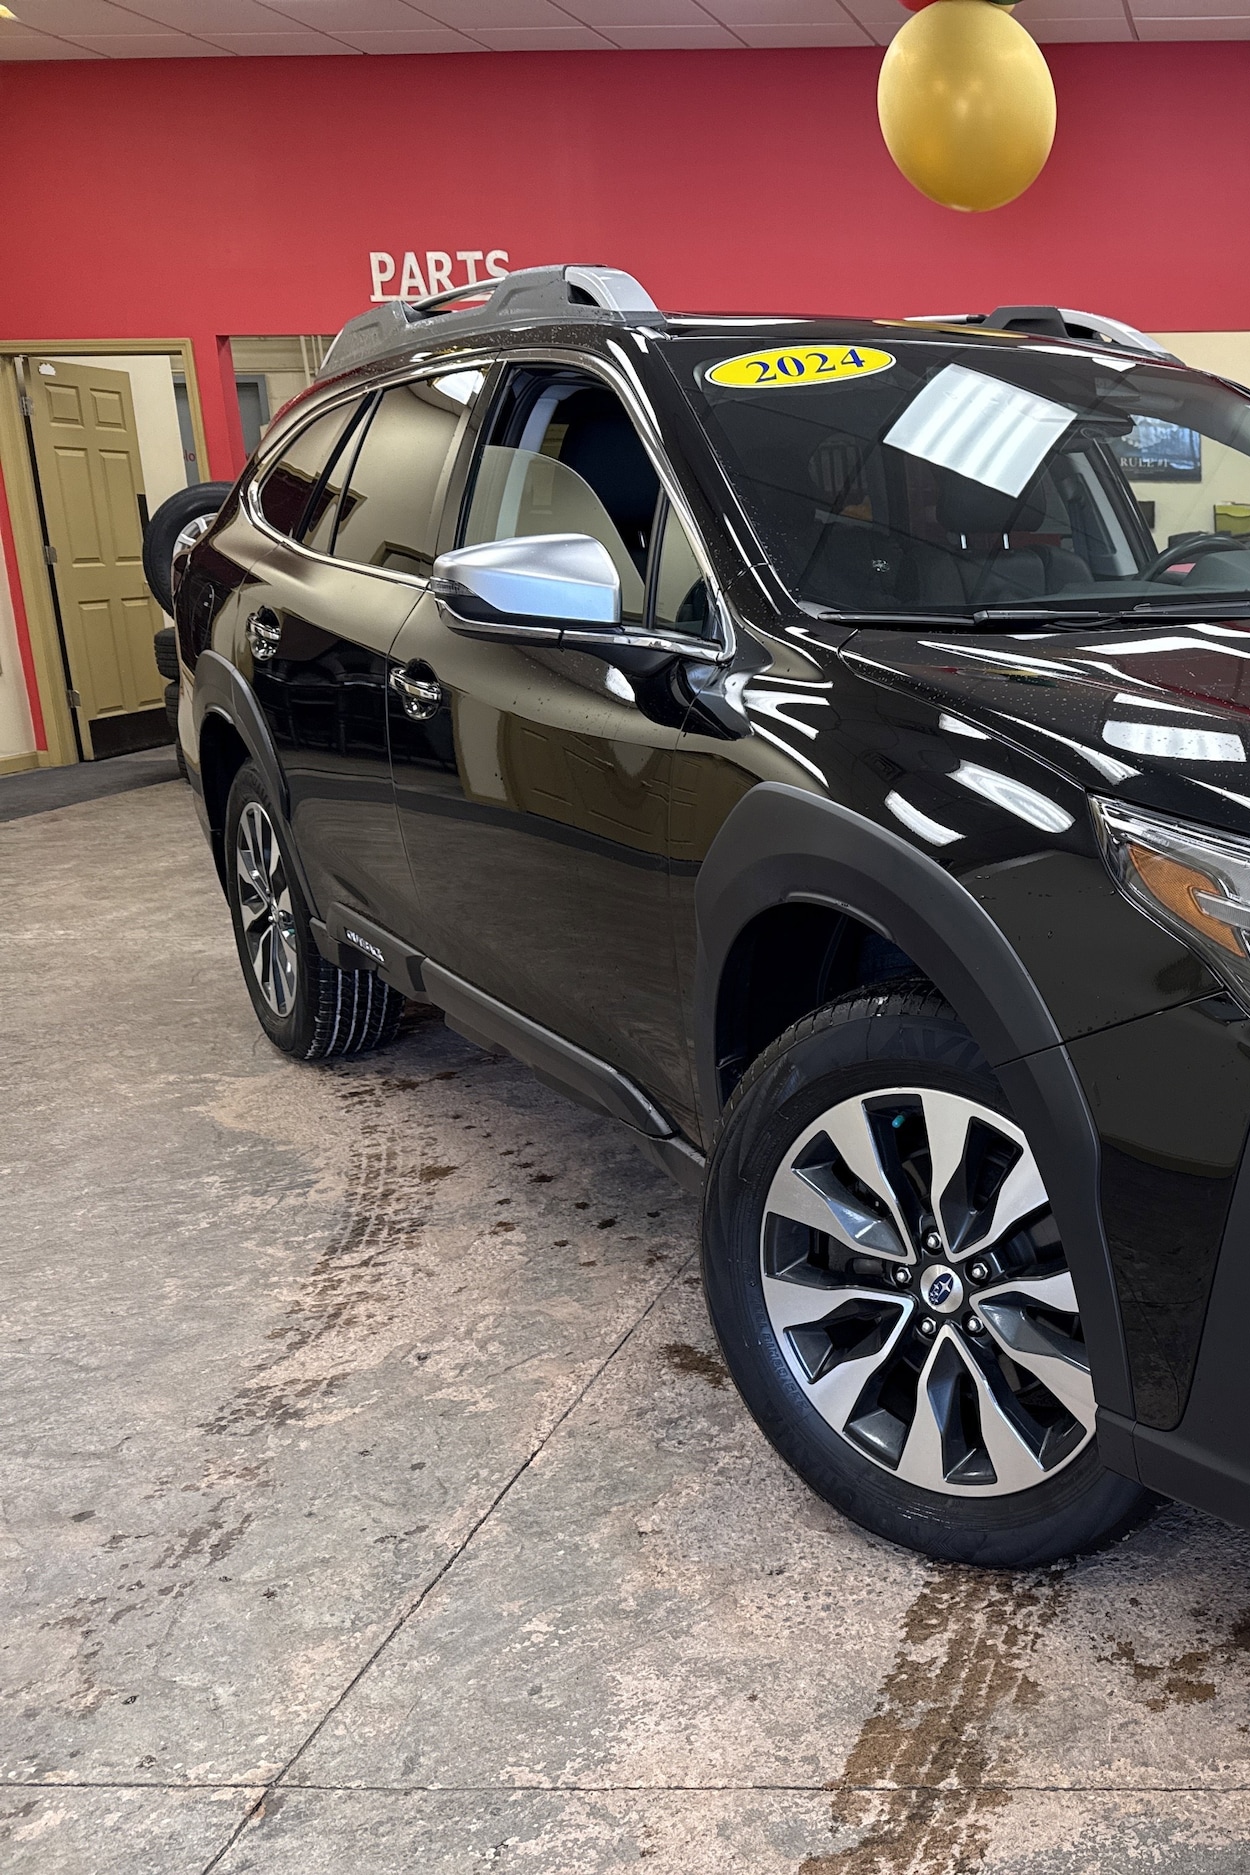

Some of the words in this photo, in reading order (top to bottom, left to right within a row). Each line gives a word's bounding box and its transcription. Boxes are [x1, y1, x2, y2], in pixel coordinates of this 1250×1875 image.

[369, 250, 510, 299] PARTS
[745, 348, 865, 384] 2024
[1120, 457, 1155, 468] RULE
